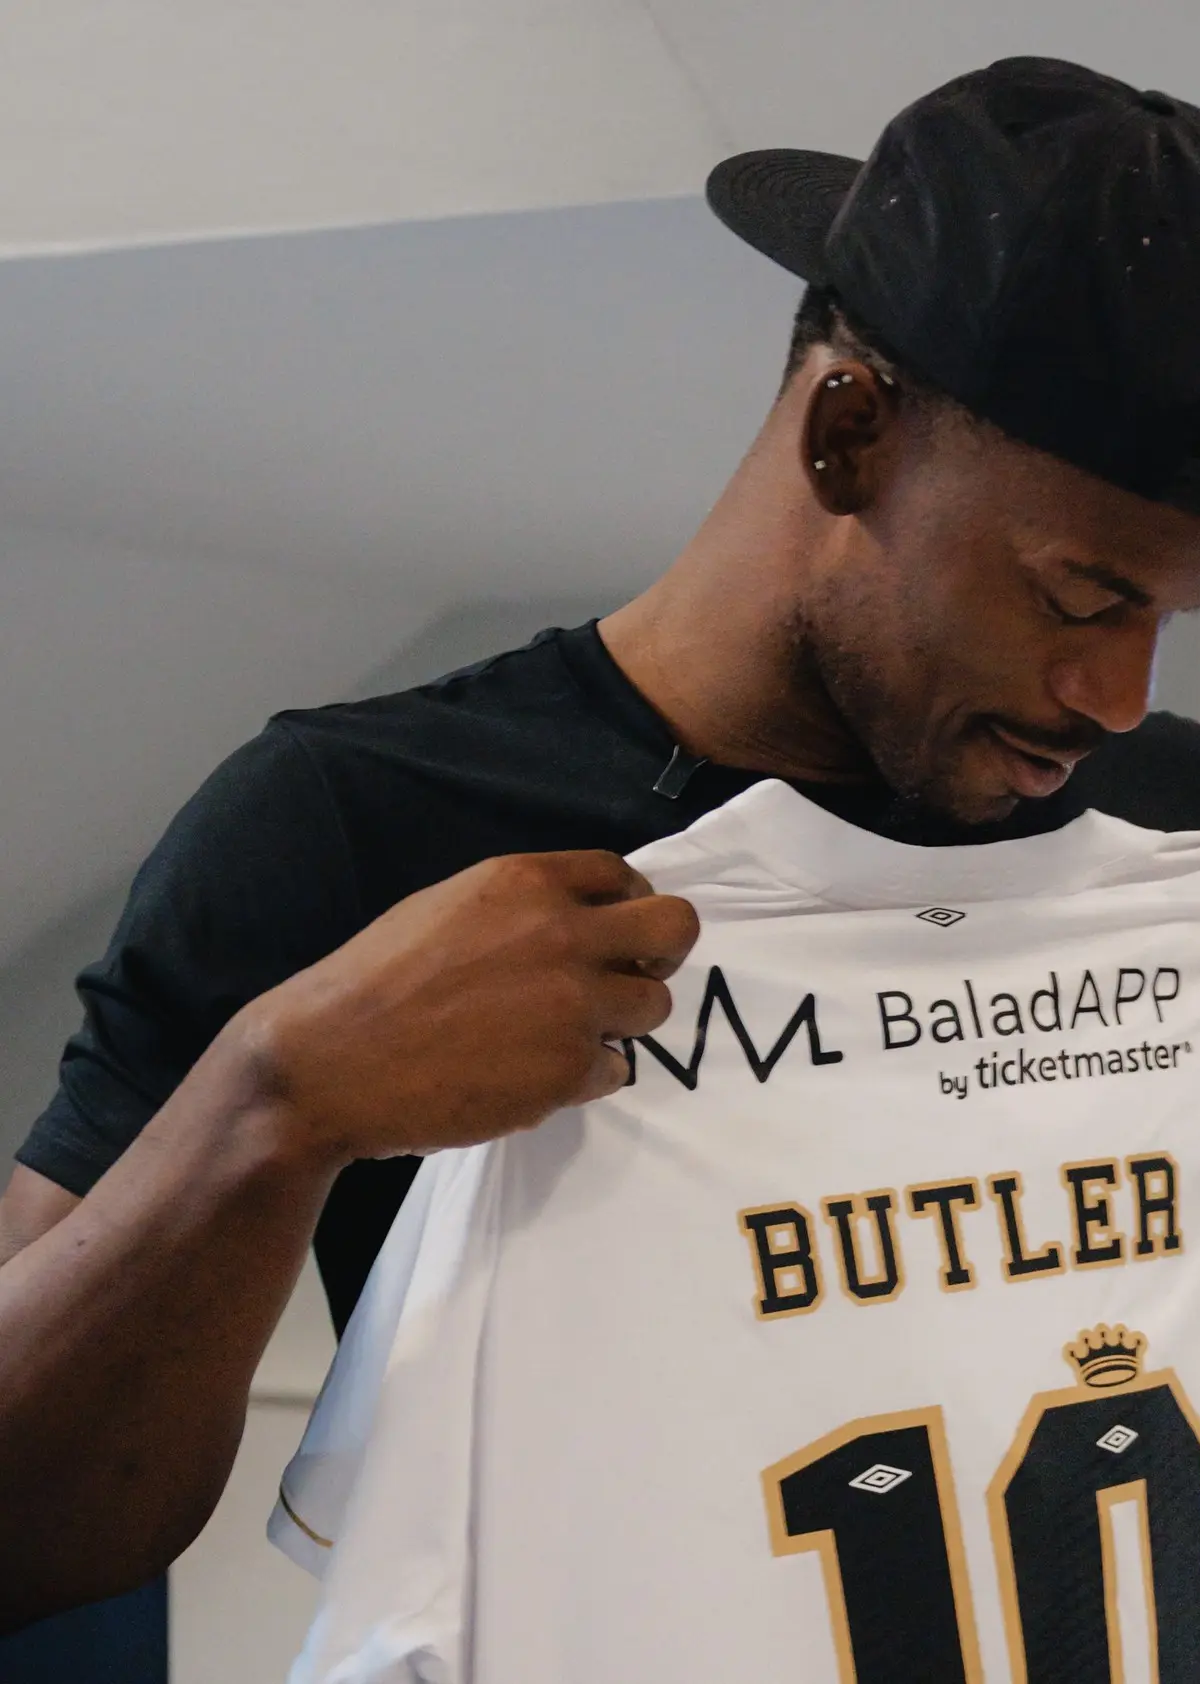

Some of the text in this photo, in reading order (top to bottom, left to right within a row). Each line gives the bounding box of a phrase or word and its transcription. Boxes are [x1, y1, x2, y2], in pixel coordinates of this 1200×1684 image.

[876, 966, 1181, 1050] BaladAPP
[939, 1071, 969, 1100] by
[738, 1151, 1184, 1320] BUTLER
